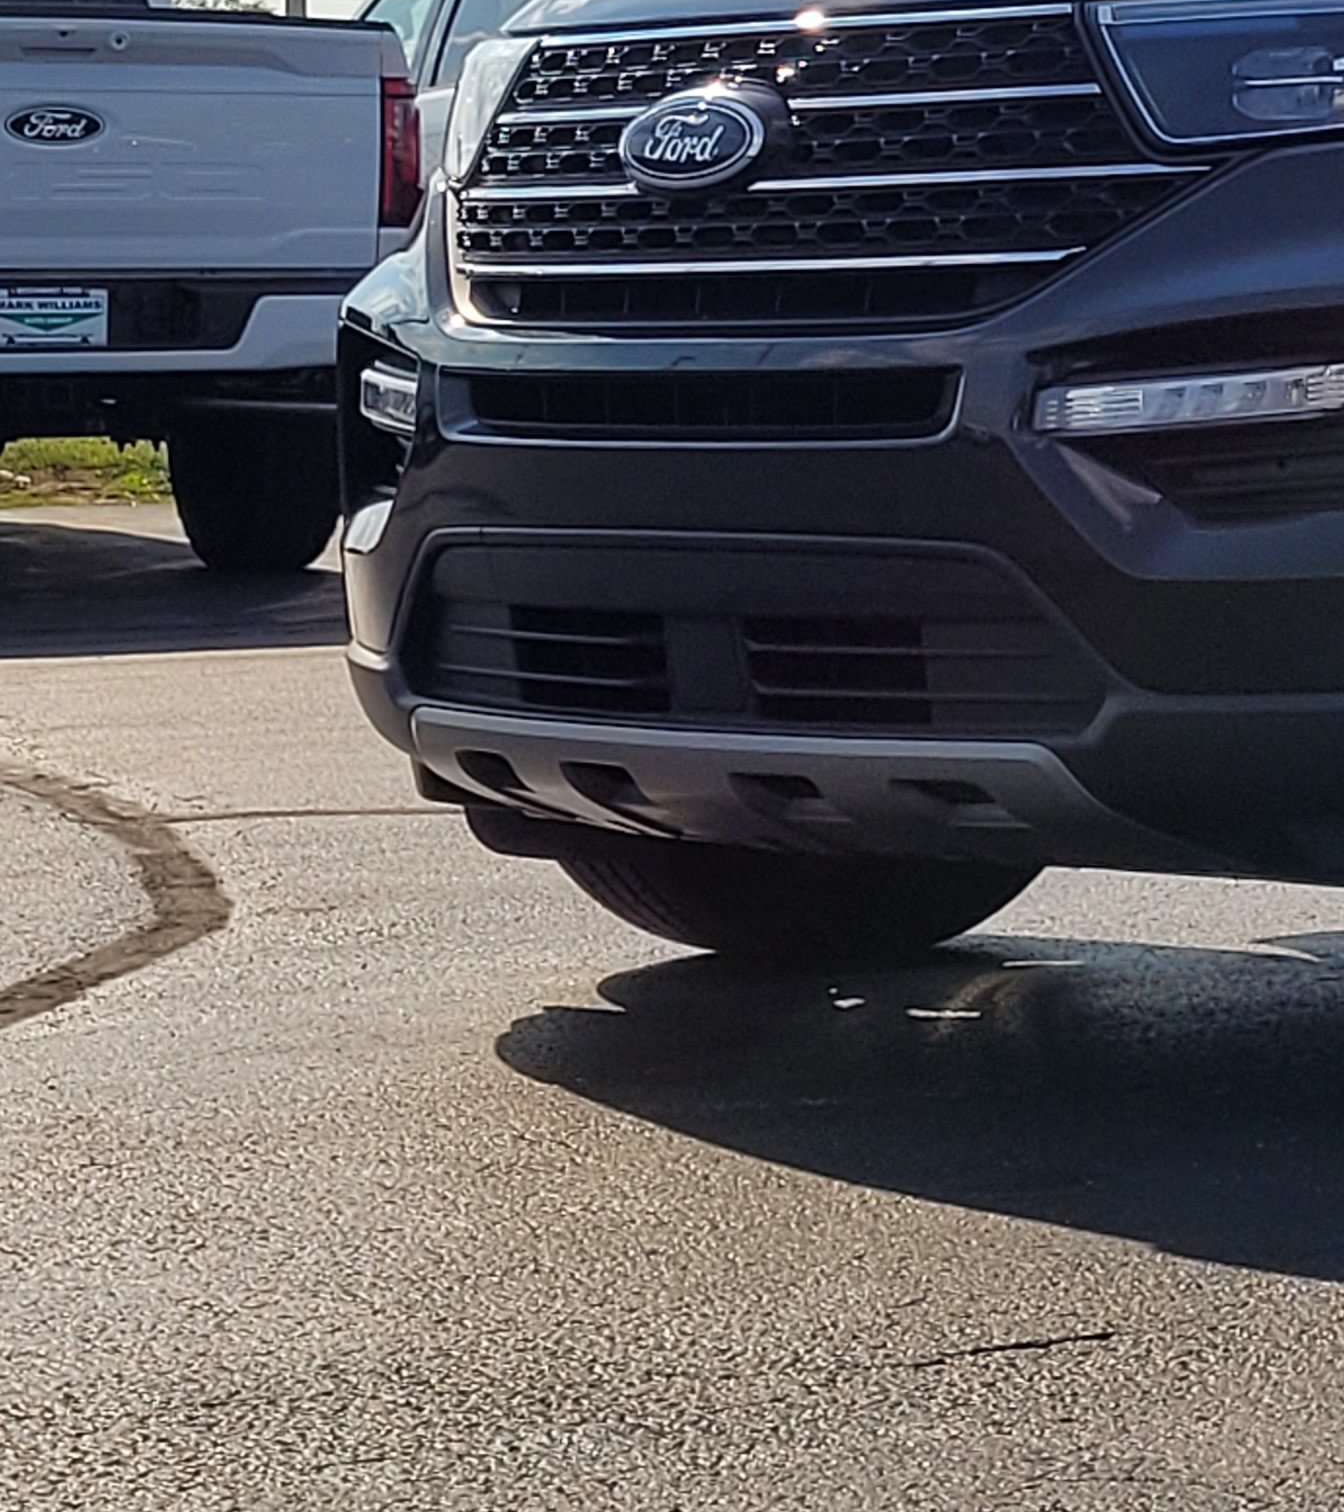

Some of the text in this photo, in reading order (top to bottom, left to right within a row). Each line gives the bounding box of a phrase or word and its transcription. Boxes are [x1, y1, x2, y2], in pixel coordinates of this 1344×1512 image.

[24, 112, 86, 138] Ford
[644, 113, 725, 163] Ford
[37, 300, 101, 310] WILLIAMS
